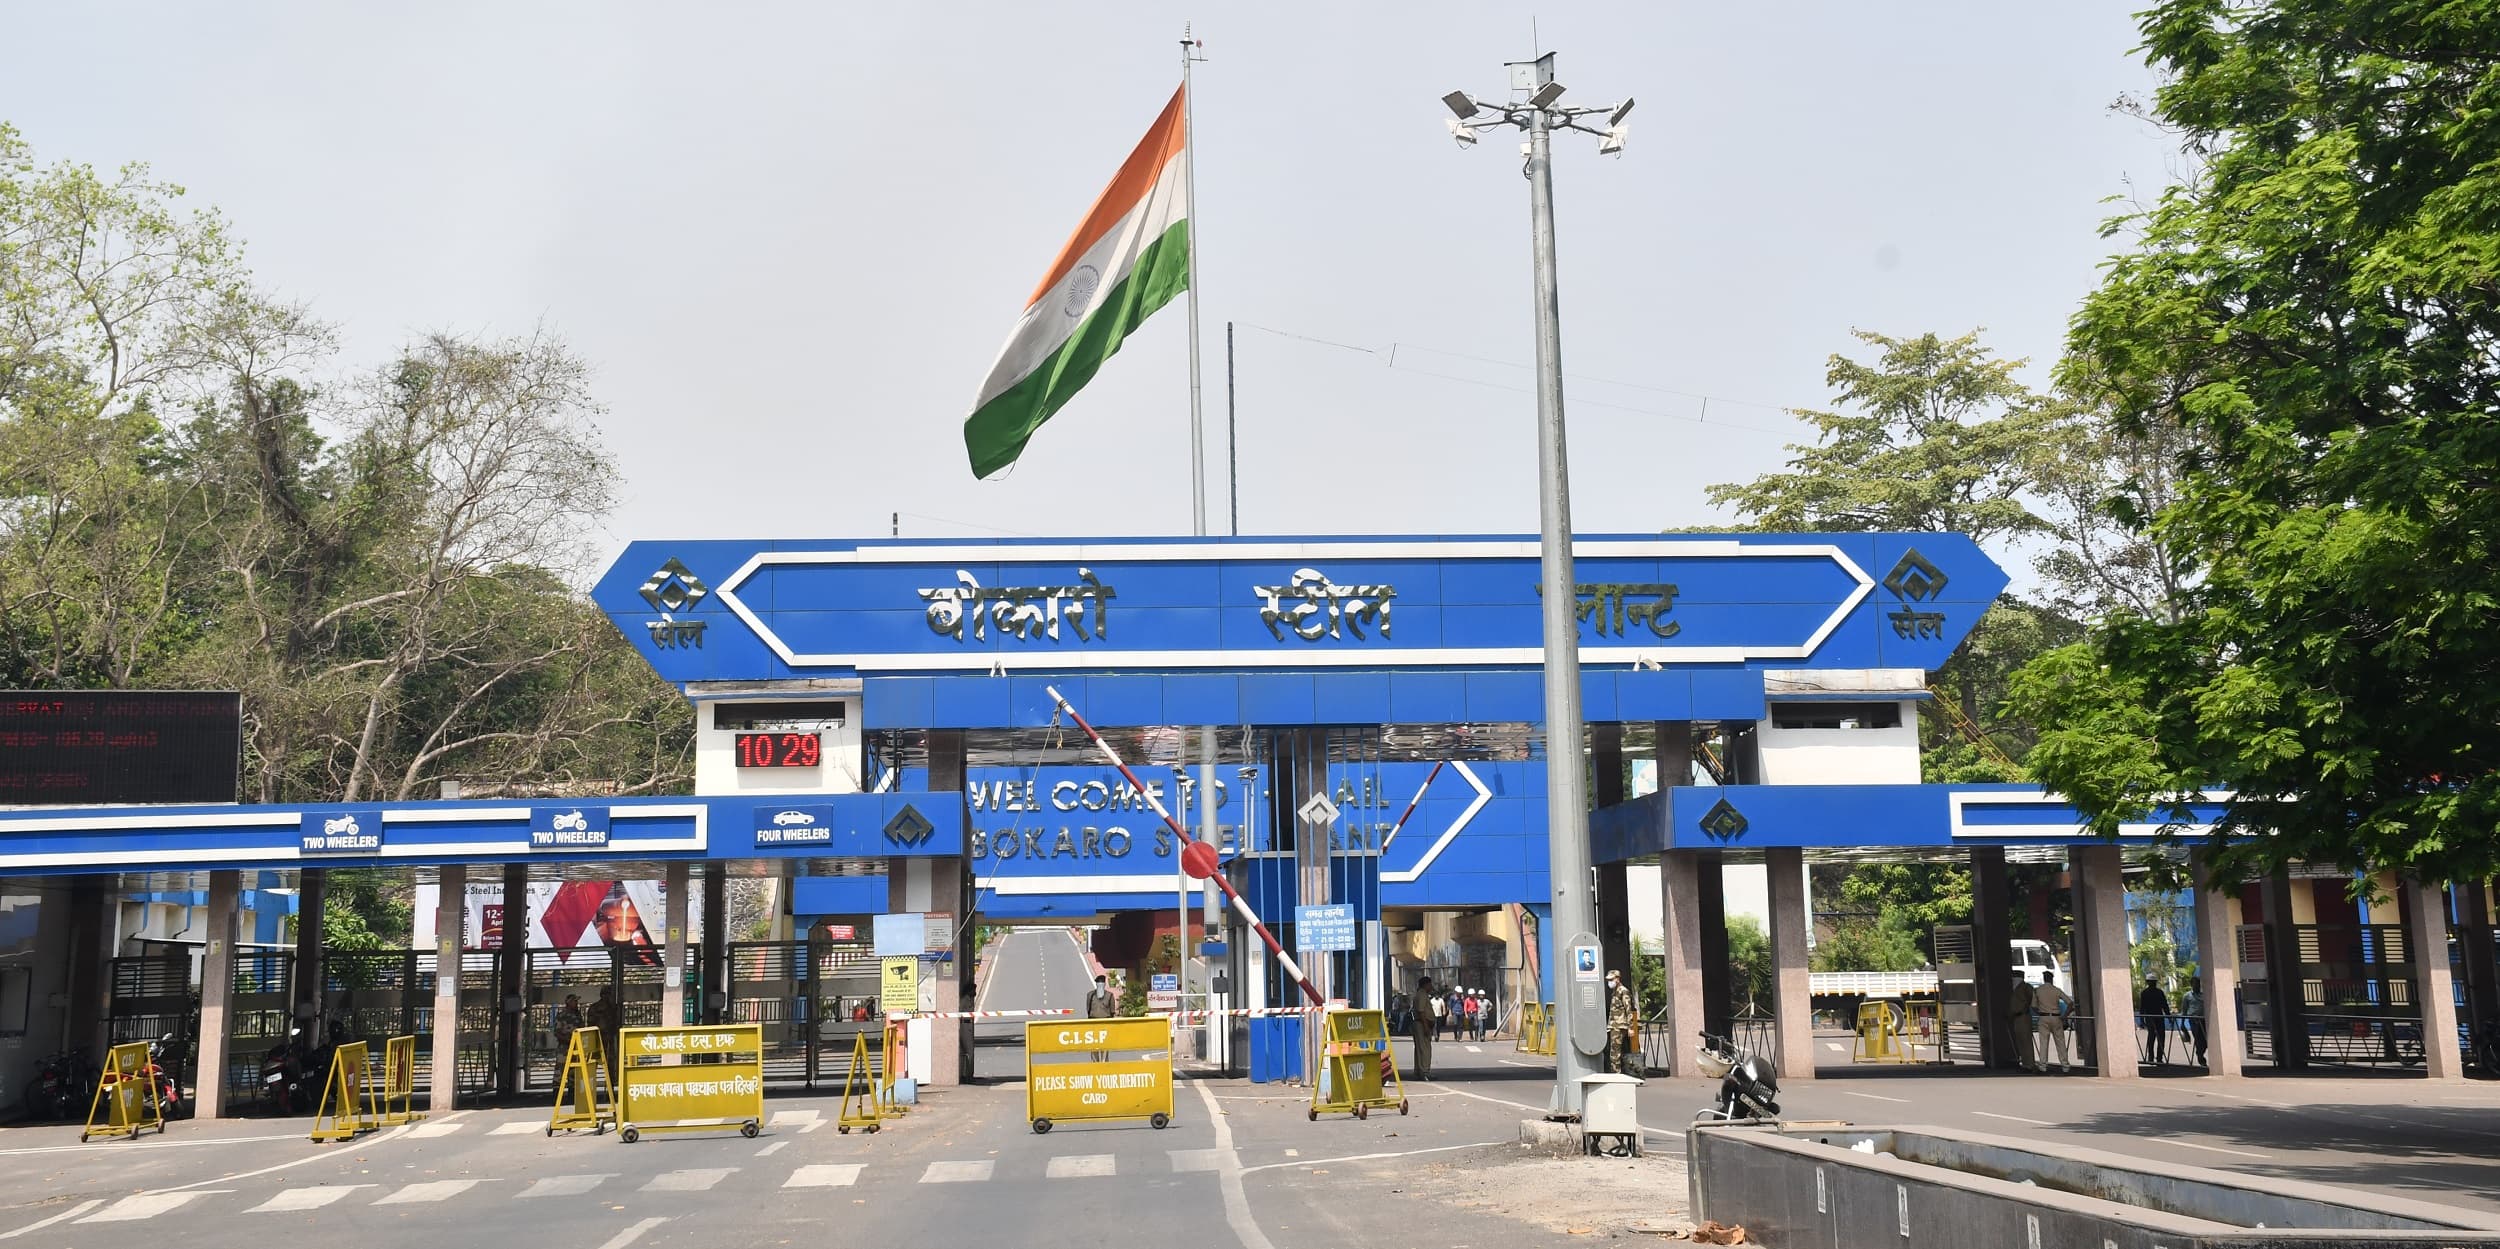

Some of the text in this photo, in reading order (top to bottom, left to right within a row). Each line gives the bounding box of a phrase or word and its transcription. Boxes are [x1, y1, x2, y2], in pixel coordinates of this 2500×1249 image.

[917, 567, 1681, 643] बोकारो स्टील लान्ट
[645, 612, 707, 649] सेल
[1887, 604, 1945, 640] सेल
[738, 733, 819, 767] 10 29
[303, 835, 378, 850] TWO WHEELERS
[532, 831, 606, 845] TWO WHEELERS
[757, 828, 830, 842] FOUR WHEELERS
[971, 826, 1131, 858] BOKARO
[470, 886, 491, 895] Steel
[1035, 1072, 1156, 1091] PLEASE SHOW YOUR IDENTITY
[1082, 1093, 1108, 1105] CARD
